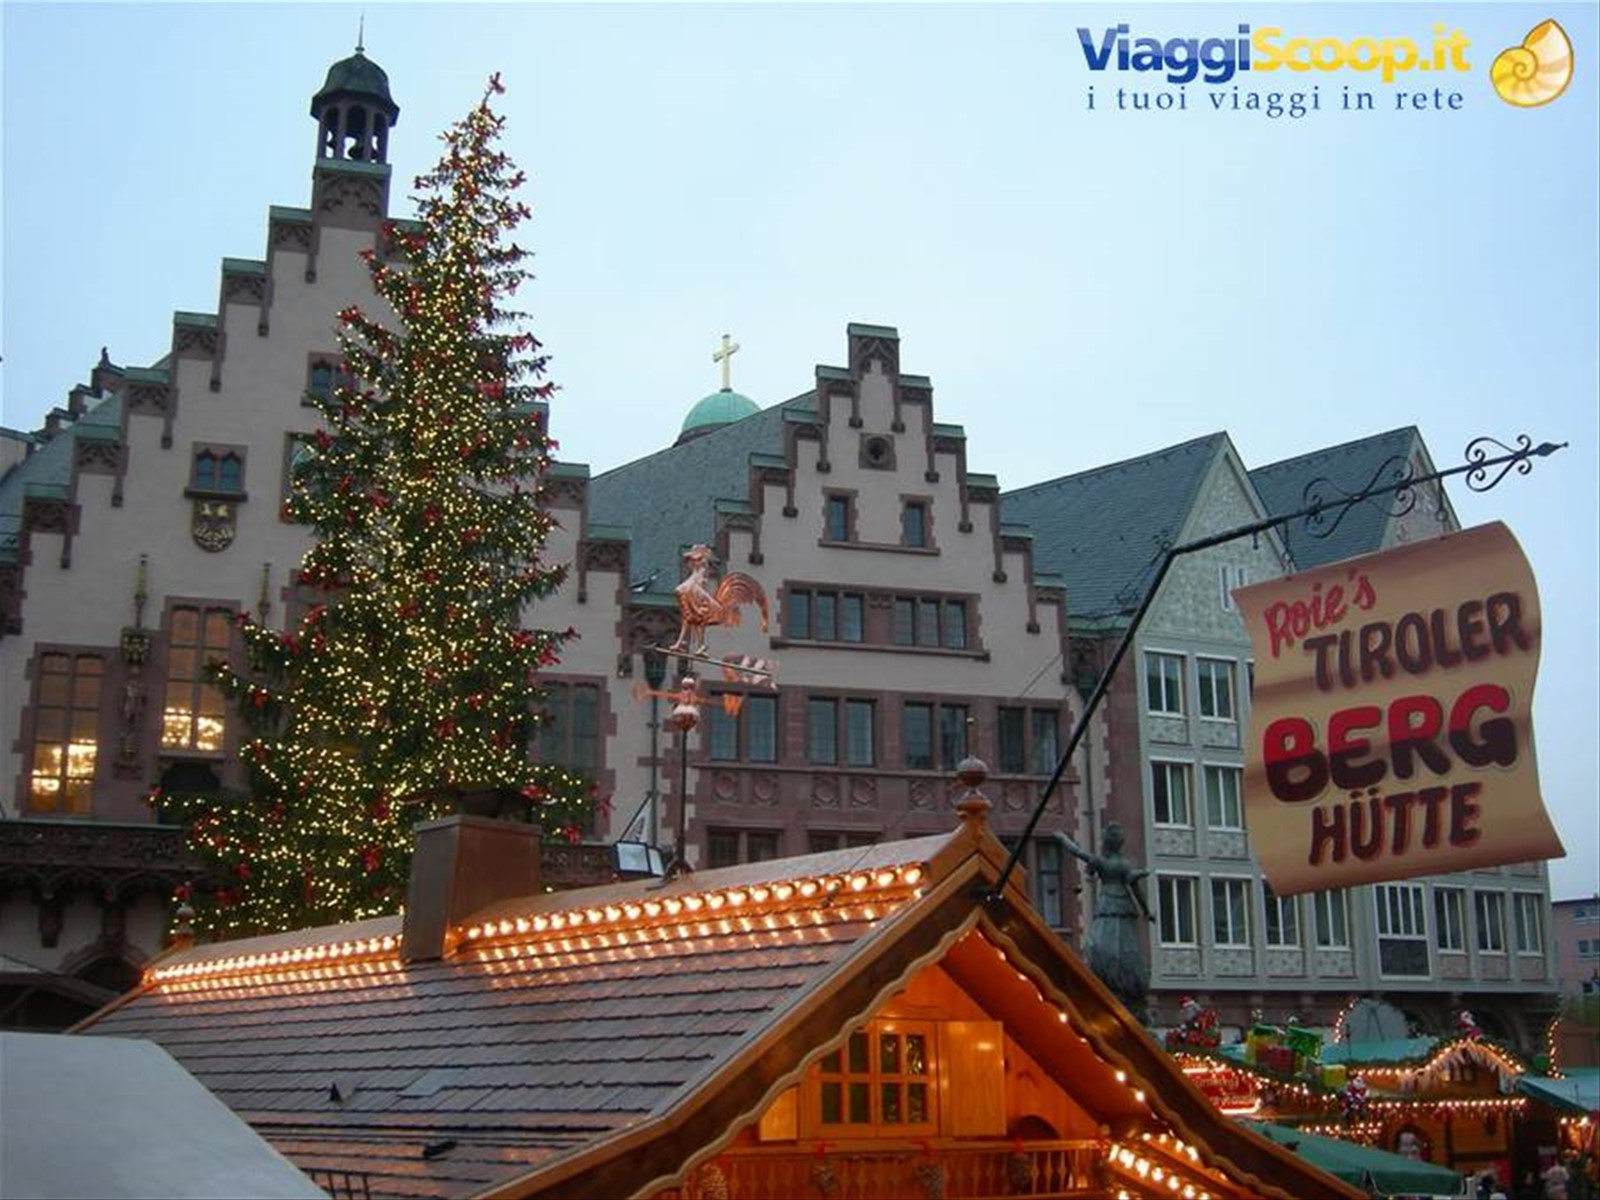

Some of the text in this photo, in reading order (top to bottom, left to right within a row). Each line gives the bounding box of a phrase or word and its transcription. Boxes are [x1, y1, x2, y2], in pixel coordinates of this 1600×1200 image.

[1303, 591, 1530, 692] TIROLER
[1263, 684, 1517, 803] BERG
[1308, 781, 1482, 866] HÜTTE
